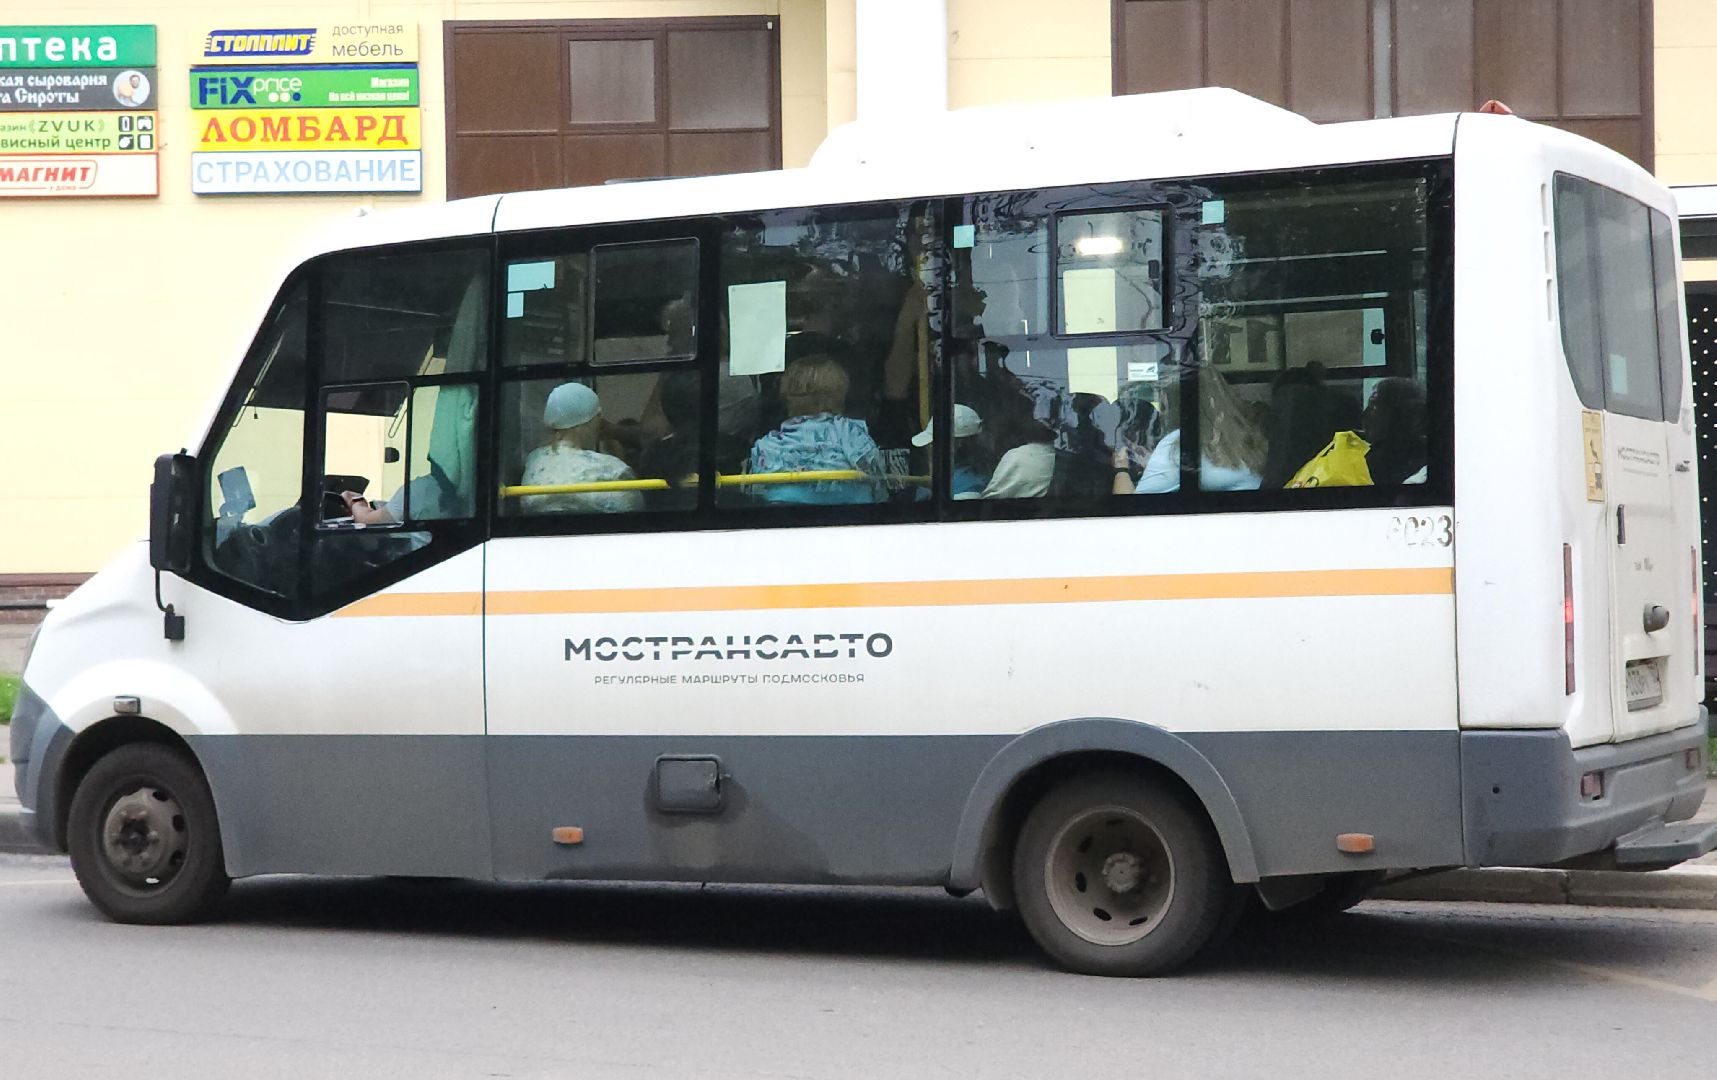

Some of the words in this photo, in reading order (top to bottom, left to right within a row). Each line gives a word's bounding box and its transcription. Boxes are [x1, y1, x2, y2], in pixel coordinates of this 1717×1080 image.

[332, 24, 404, 37] доступная
[332, 41, 404, 57] мебель
[27, 75, 108, 90] сыроварня
[15, 88, 80, 107] Сироты
[201, 116, 409, 145] ЛОМБАРД
[65, 138, 111, 150] центр
[0, 167, 91, 182] МАГНИТ
[197, 159, 416, 184] СТРАХОВАНИЕ
[564, 633, 893, 662] МОСТРАНСАВТО
[682, 674, 758, 684] МАРШРУТЫ
